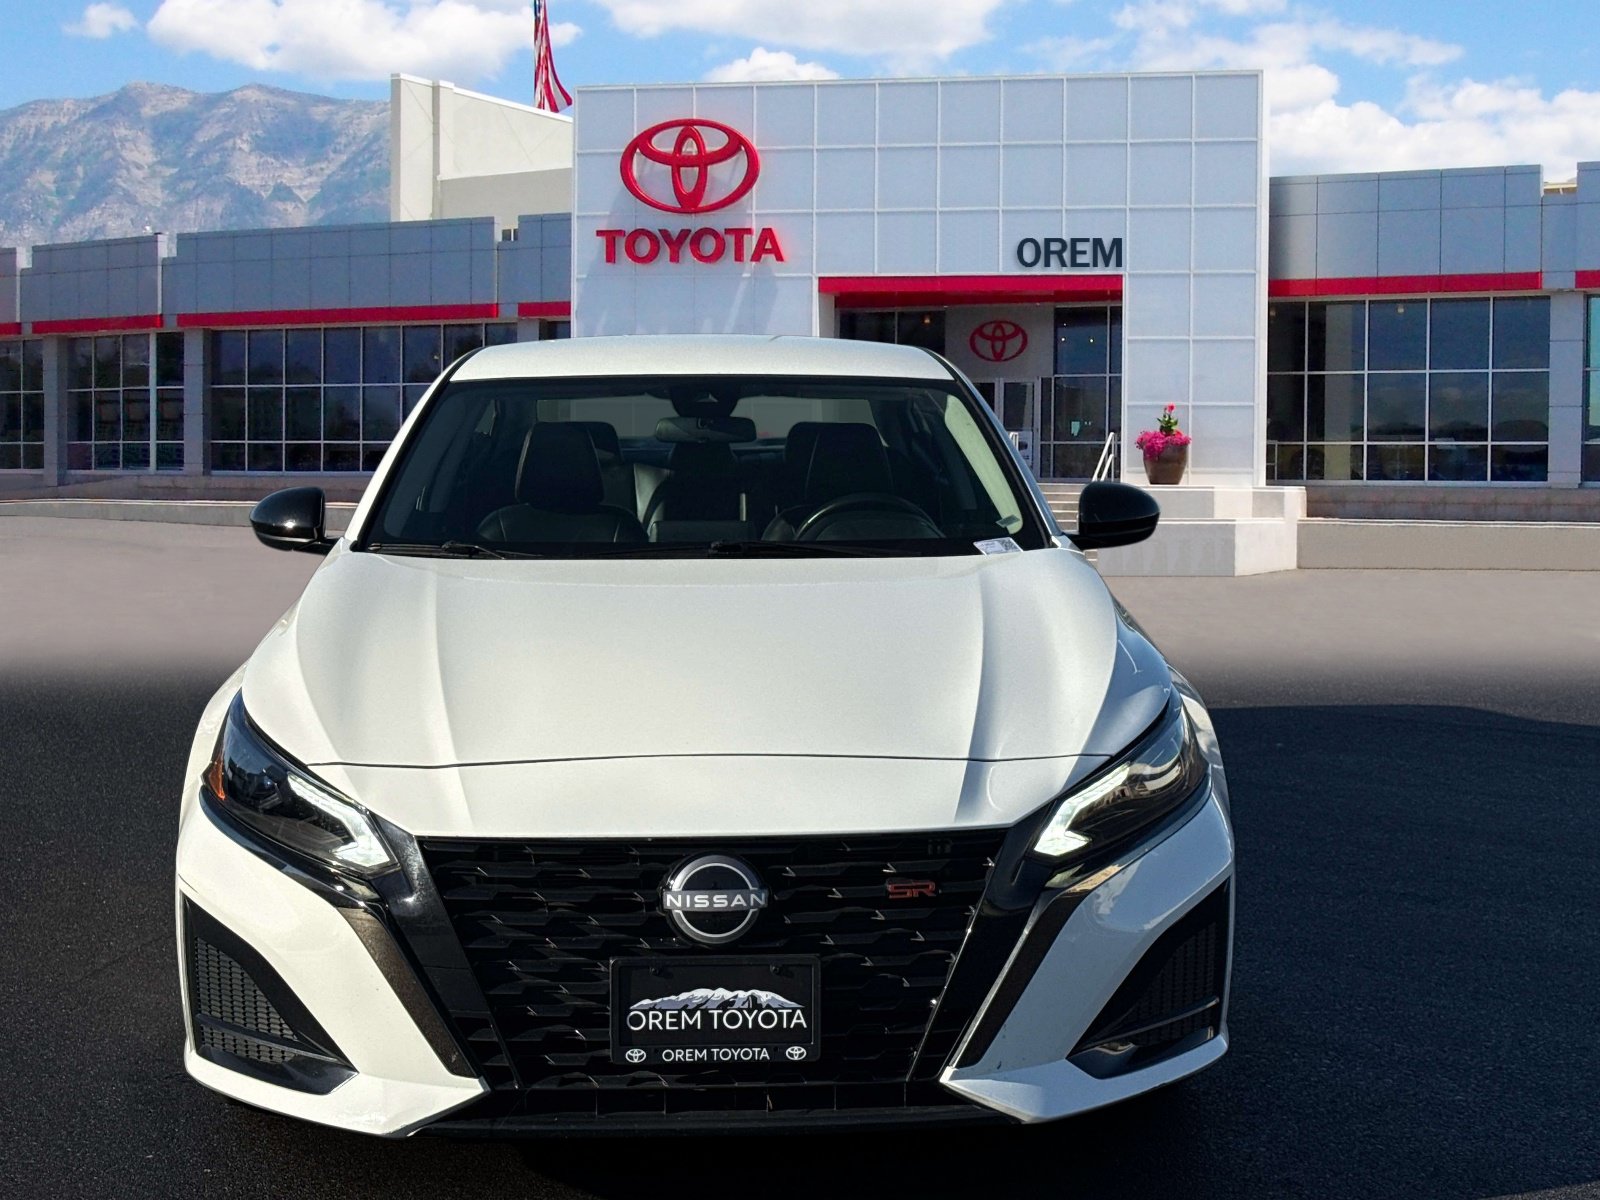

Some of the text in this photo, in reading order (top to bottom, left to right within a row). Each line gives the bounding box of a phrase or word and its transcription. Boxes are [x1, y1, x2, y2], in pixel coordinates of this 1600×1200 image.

[596, 227, 785, 264] TOYOTA
[1017, 237, 1123, 268] OREM
[886, 881, 936, 898] SR
[666, 892, 766, 908] NISSAN
[626, 1009, 808, 1031] OREM TOYOTA
[662, 1048, 770, 1062] OREM TOYOTA
